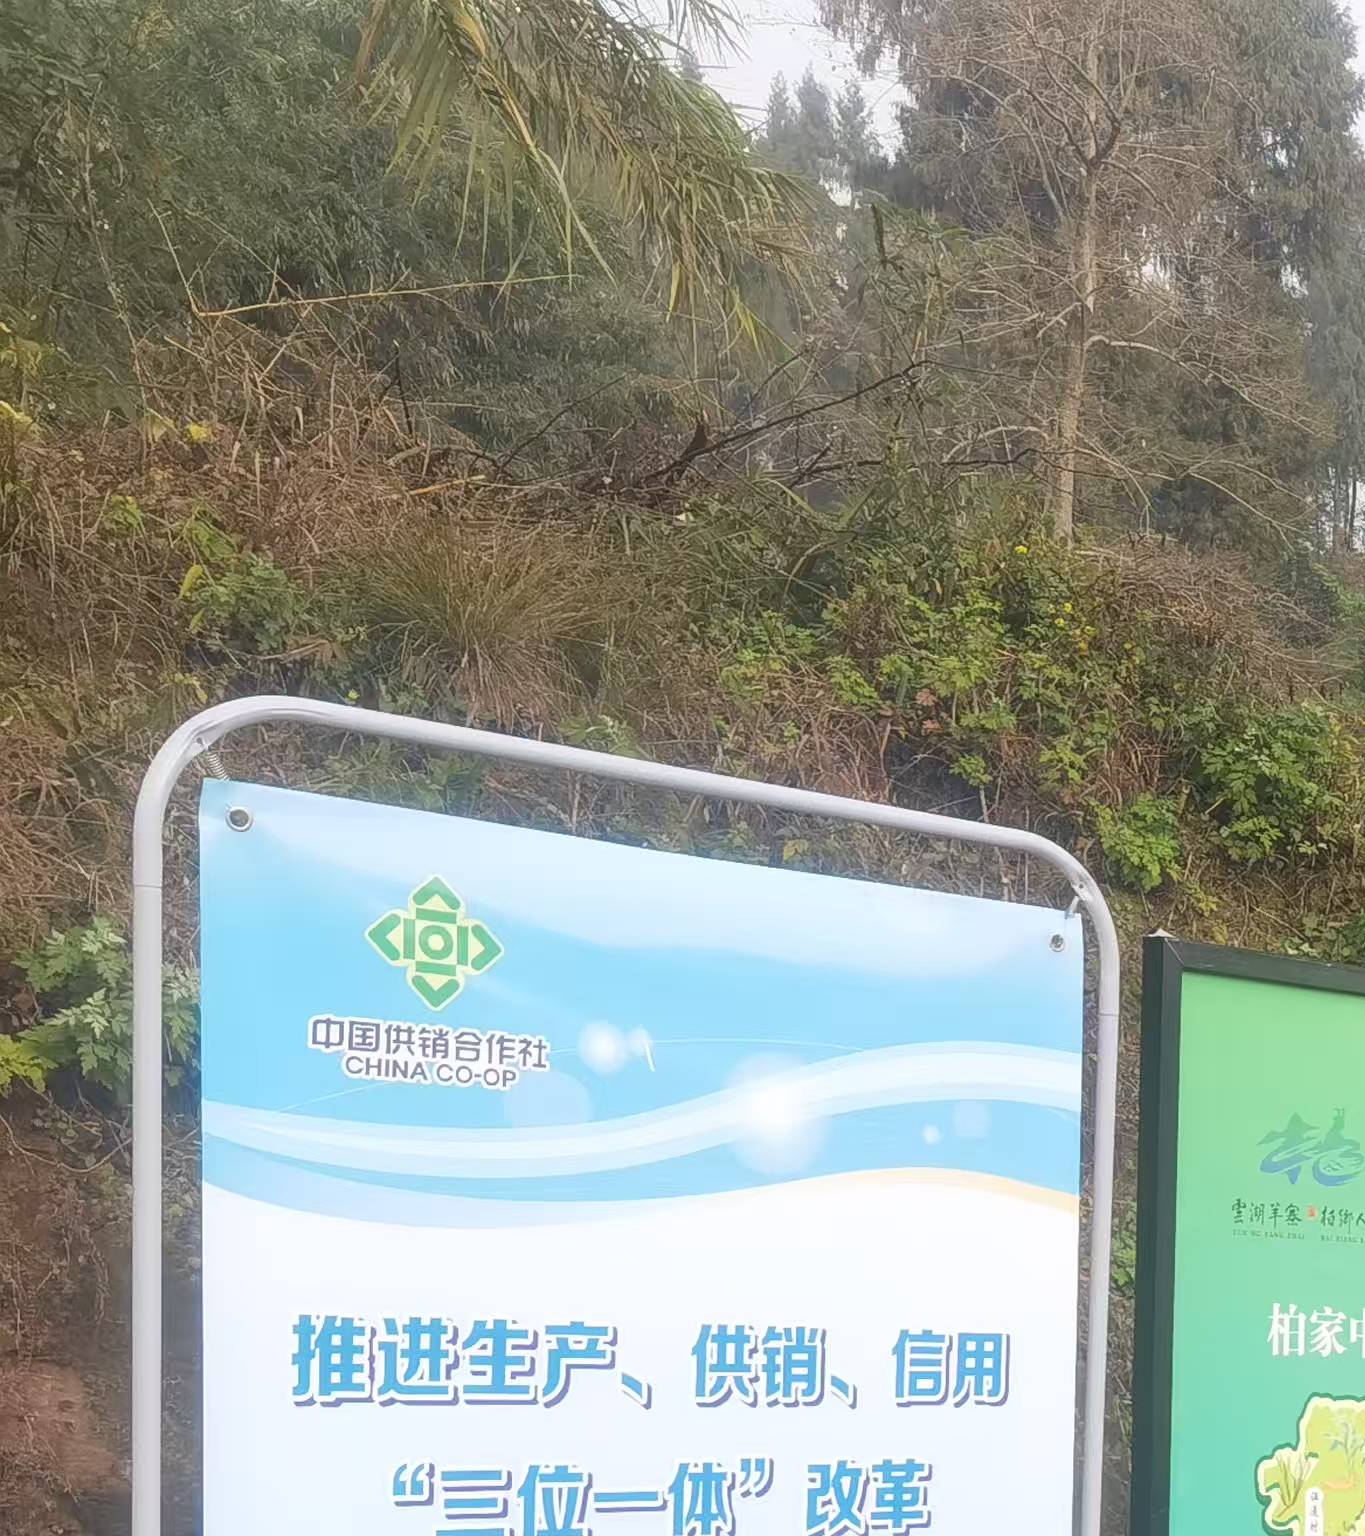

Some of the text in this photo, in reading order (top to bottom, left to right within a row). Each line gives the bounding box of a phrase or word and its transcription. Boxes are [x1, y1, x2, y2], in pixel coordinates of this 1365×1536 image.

[310, 1014, 551, 1072] 中国供销合作社
[345, 1055, 518, 1089] CHINA CO-OP
[291, 1314, 1010, 1408] 推进生产、供销、信用
